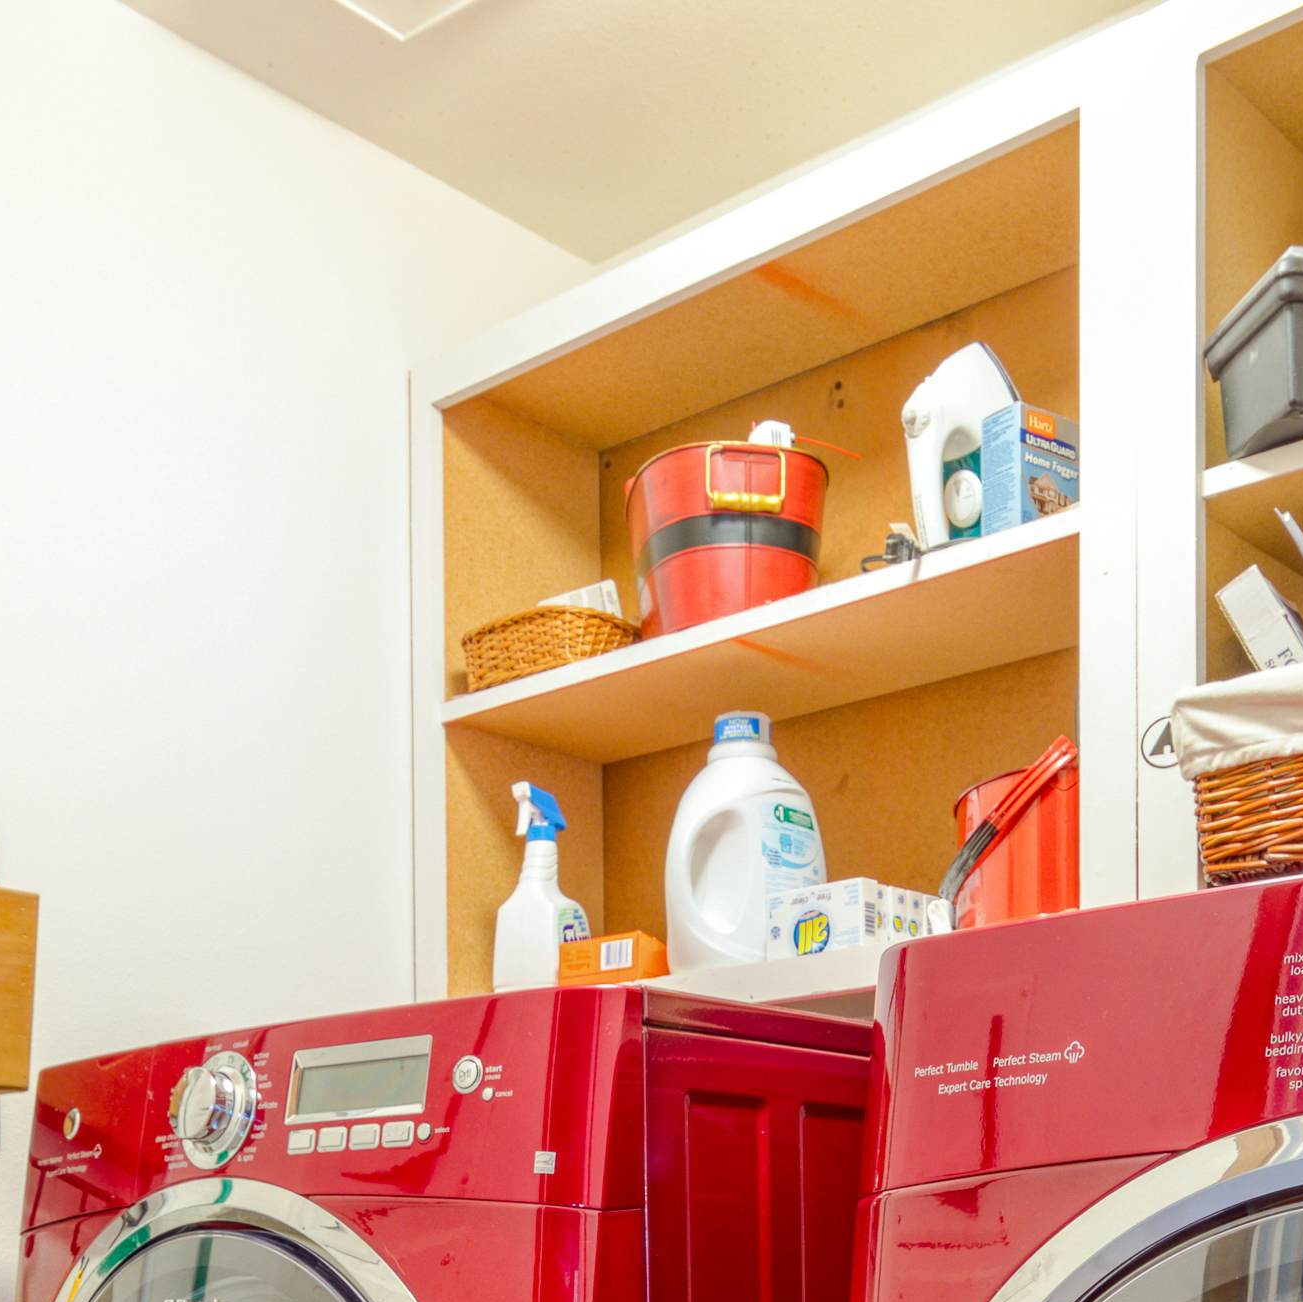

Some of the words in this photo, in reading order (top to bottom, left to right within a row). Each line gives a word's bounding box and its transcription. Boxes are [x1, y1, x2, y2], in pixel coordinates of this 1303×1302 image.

[1029, 415, 1054, 433] Hartz
[1025, 452, 1051, 468] Home
[798, 914, 828, 956] all
[993, 1055, 1027, 1068] Perfect
[1029, 1051, 1062, 1064] Steam
[485, 1065, 502, 1073] start
[914, 1065, 944, 1078] Perfect
[946, 1060, 978, 1073] Tumble
[938, 1082, 968, 1095] Expert
[969, 1079, 991, 1090] Care
[993, 1072, 1048, 1088] Technology
